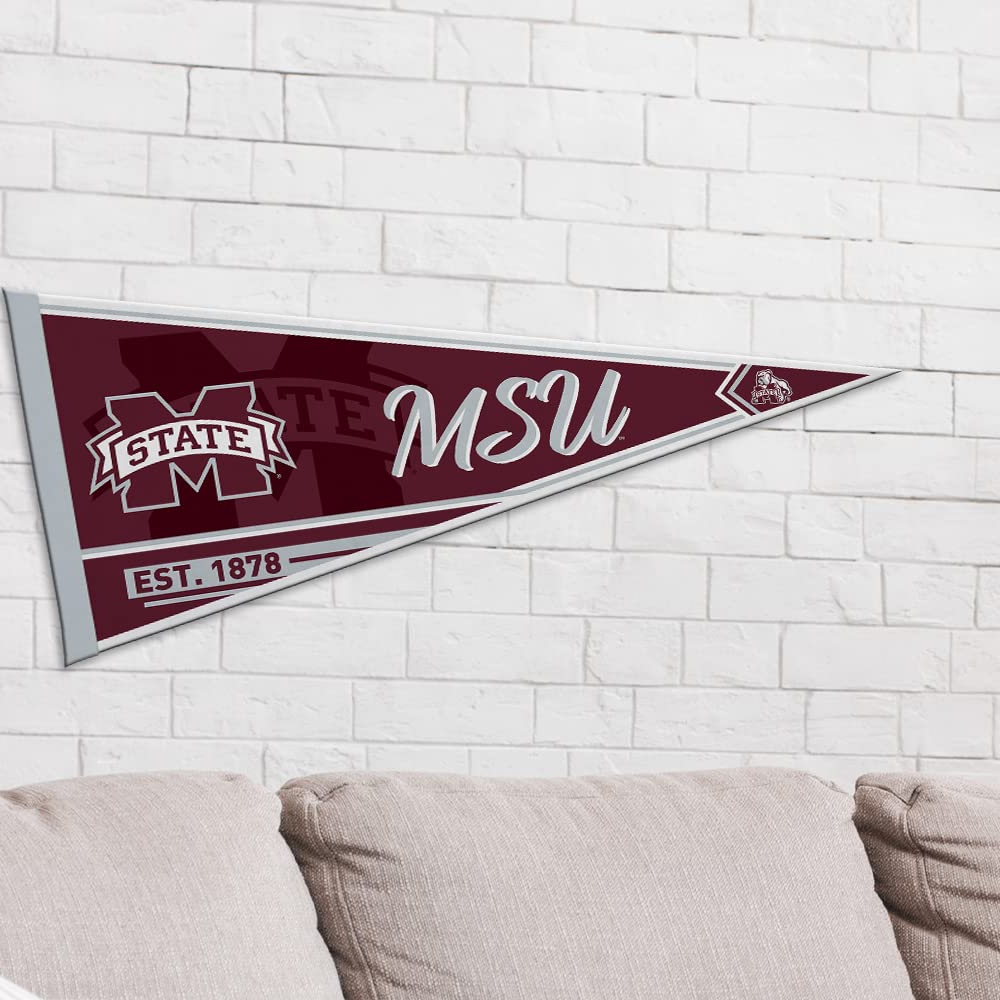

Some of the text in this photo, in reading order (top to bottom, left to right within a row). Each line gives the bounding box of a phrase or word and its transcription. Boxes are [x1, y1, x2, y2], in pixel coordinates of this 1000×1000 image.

[383, 368, 631, 477] MSU
[127, 424, 252, 467] STATE
[133, 552, 282, 594] EST. 1878
